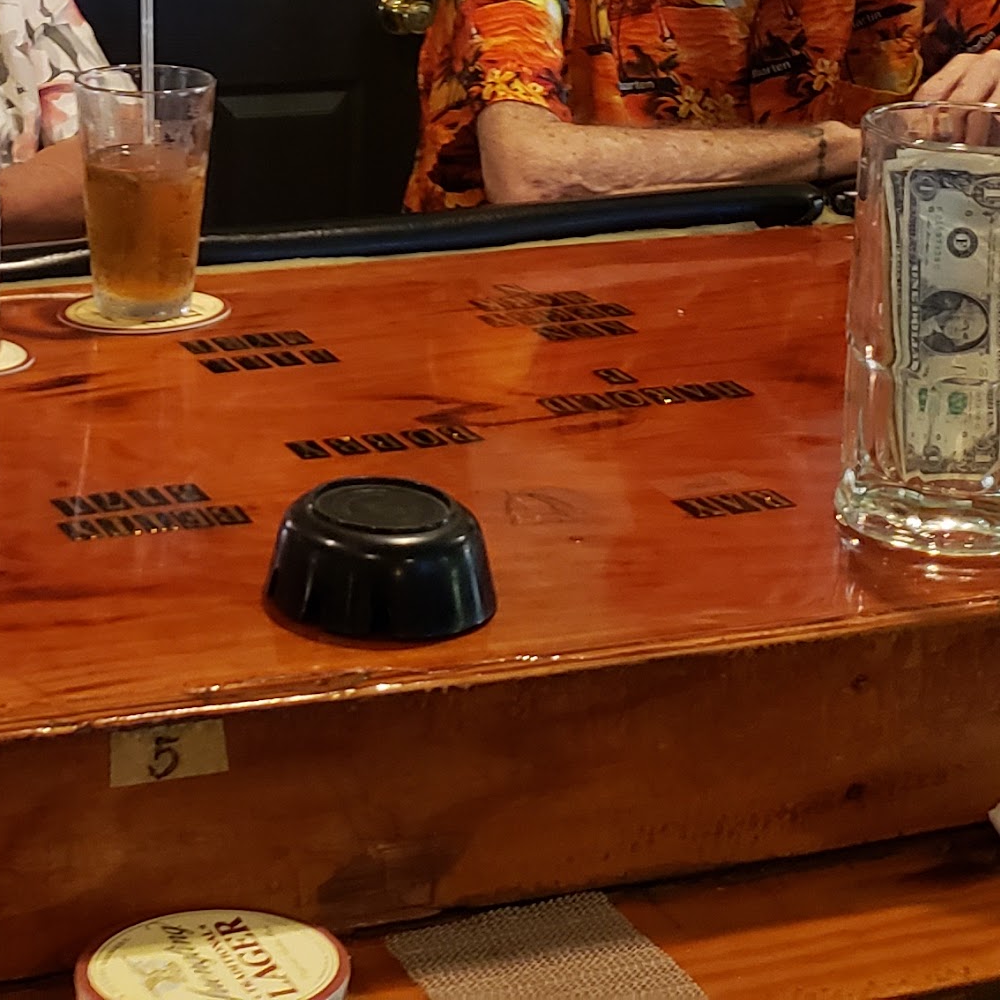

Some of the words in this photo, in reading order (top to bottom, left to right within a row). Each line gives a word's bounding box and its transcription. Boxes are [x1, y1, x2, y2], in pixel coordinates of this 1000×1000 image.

[536, 381, 753, 415] HAROLD
[670, 488, 796, 519] RAY
[147, 736, 179, 780] 5
[213, 916, 298, 998] LAGER
